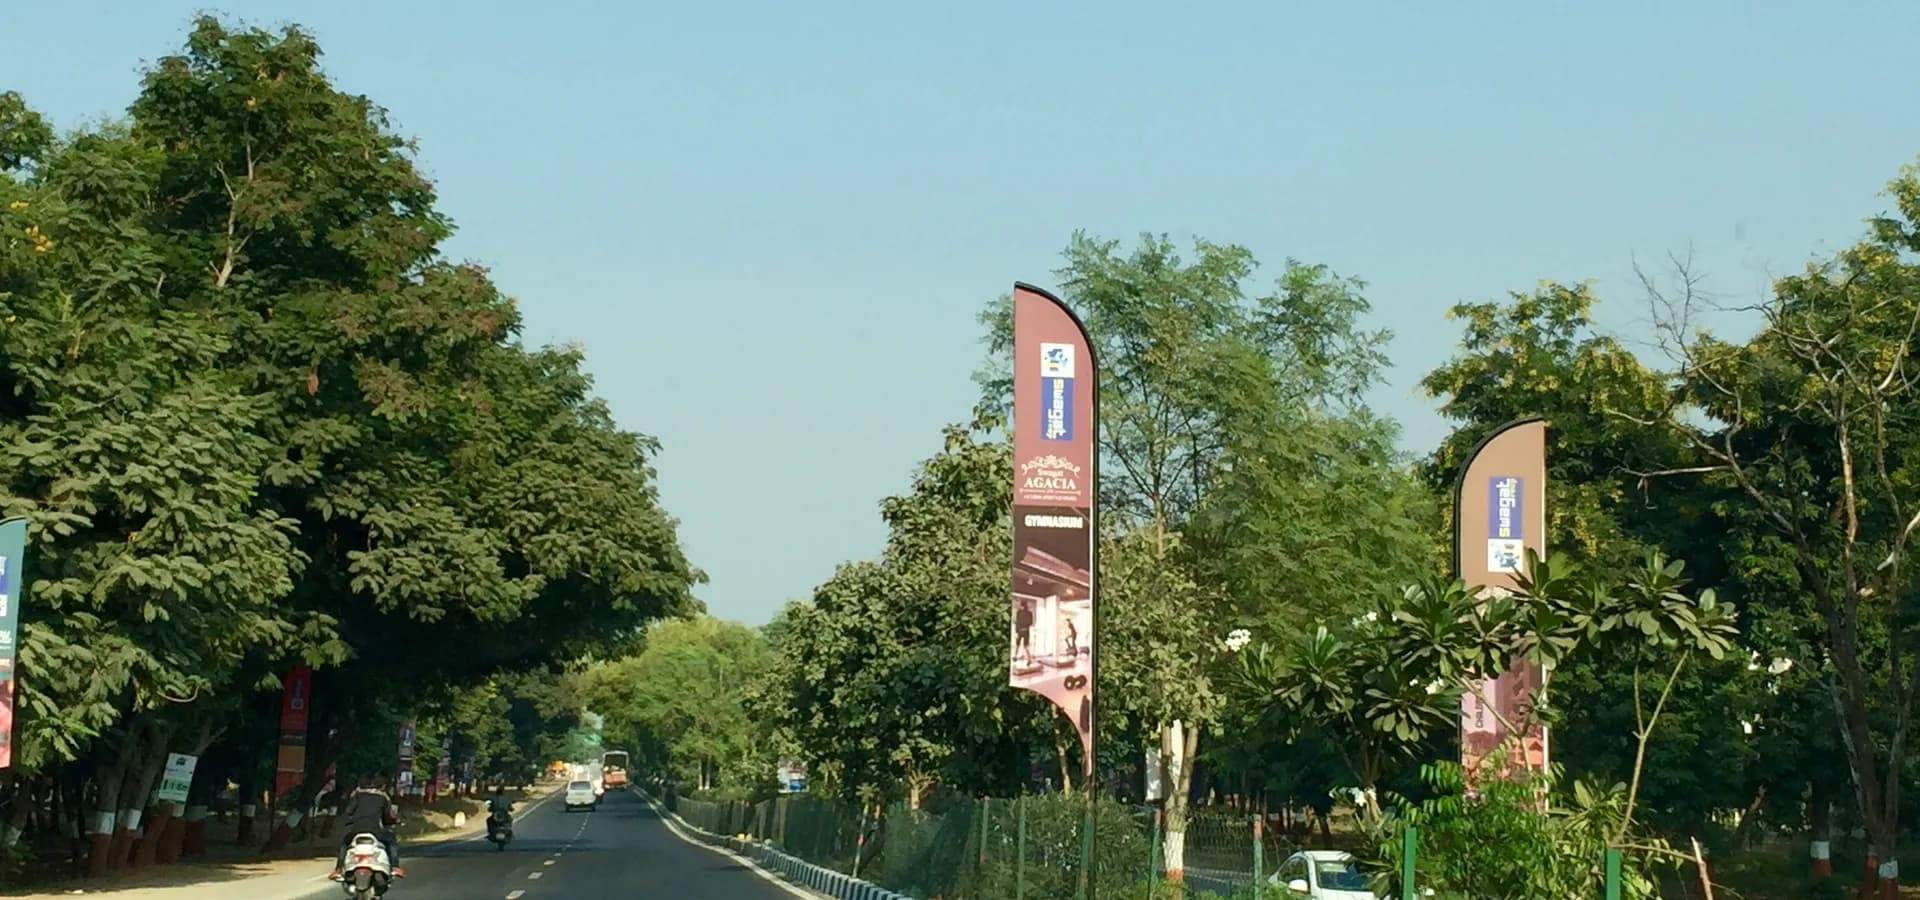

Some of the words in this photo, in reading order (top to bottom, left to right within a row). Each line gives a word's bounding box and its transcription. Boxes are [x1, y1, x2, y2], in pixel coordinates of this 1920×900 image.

[1048, 379, 1066, 440] swagat
[1024, 477, 1076, 490] AGACIA
[1024, 514, 1083, 529] GYMNASIUM
[1496, 478, 1515, 538] swagat
